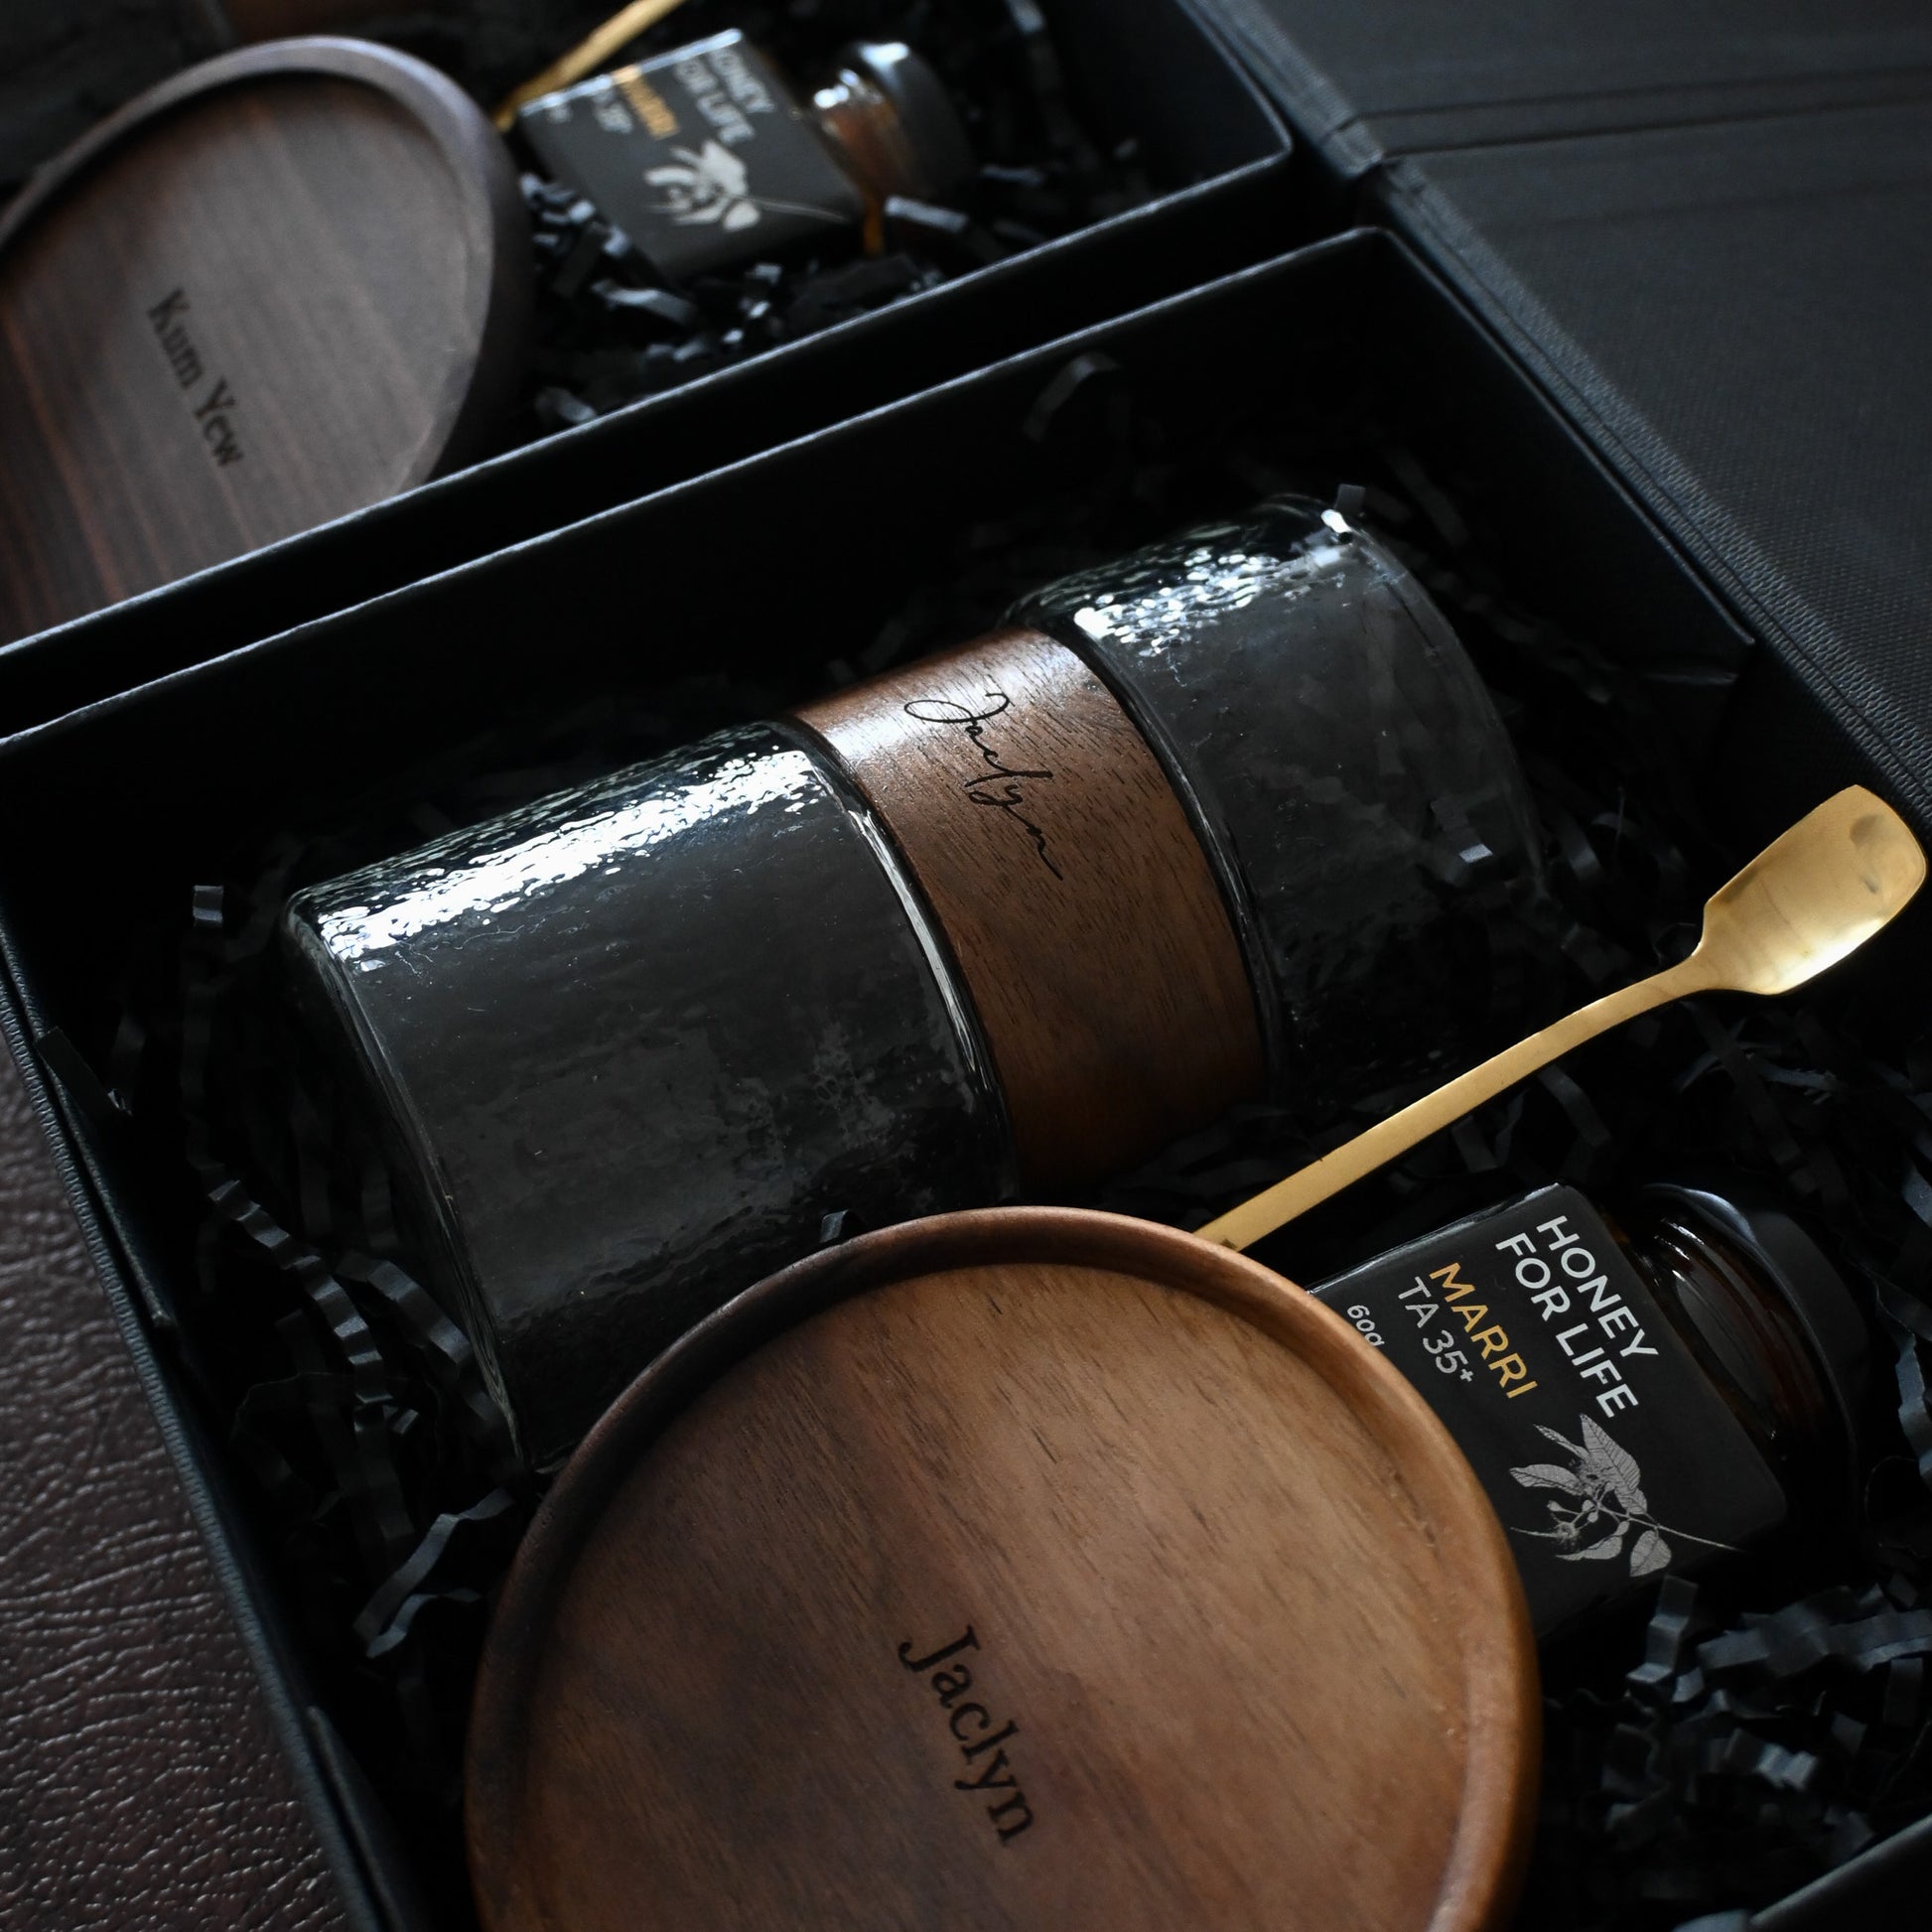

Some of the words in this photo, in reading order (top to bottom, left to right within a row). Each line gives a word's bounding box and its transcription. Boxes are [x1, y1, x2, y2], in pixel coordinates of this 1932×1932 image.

[193, 374, 245, 468] Yew
[903, 692, 1063, 882] Jaclyn
[1398, 1276, 1440, 1329] TA
[1422, 1329, 1474, 1383] 35+
[1429, 1262, 1538, 1399] MARRI
[1495, 1232, 1571, 1321] FOR
[1555, 1322, 1639, 1419] LIFE
[1536, 1214, 1659, 1359] HONEY
[897, 1624, 1035, 1844] Jaclyn
